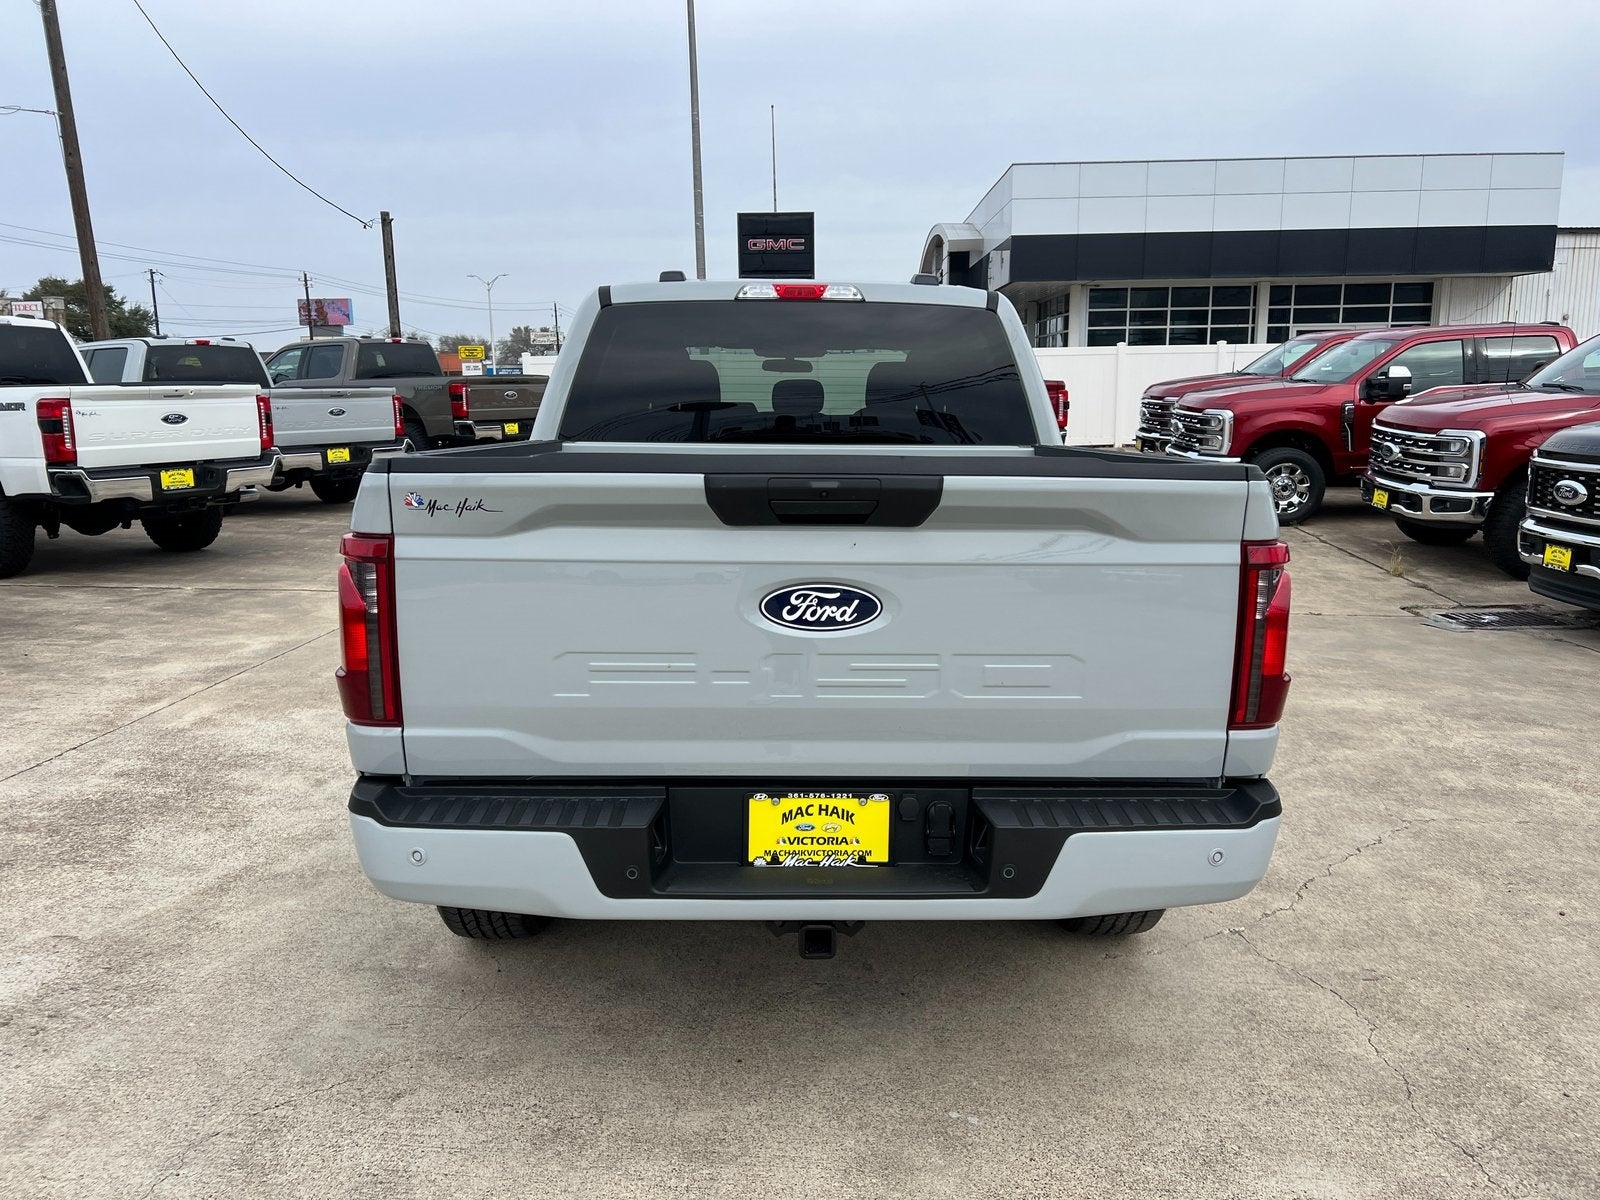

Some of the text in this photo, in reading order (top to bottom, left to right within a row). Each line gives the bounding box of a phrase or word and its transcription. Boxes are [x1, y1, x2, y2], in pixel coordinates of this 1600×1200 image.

[748, 239, 805, 250] GMC
[88, 426, 250, 442] SUPER DUTY
[424, 497, 503, 518] Mac Haik
[782, 590, 860, 622] Ford
[781, 804, 855, 825] MAC HAIK
[787, 836, 849, 846] VICTORIA
[781, 854, 868, 867] Mac Haik
